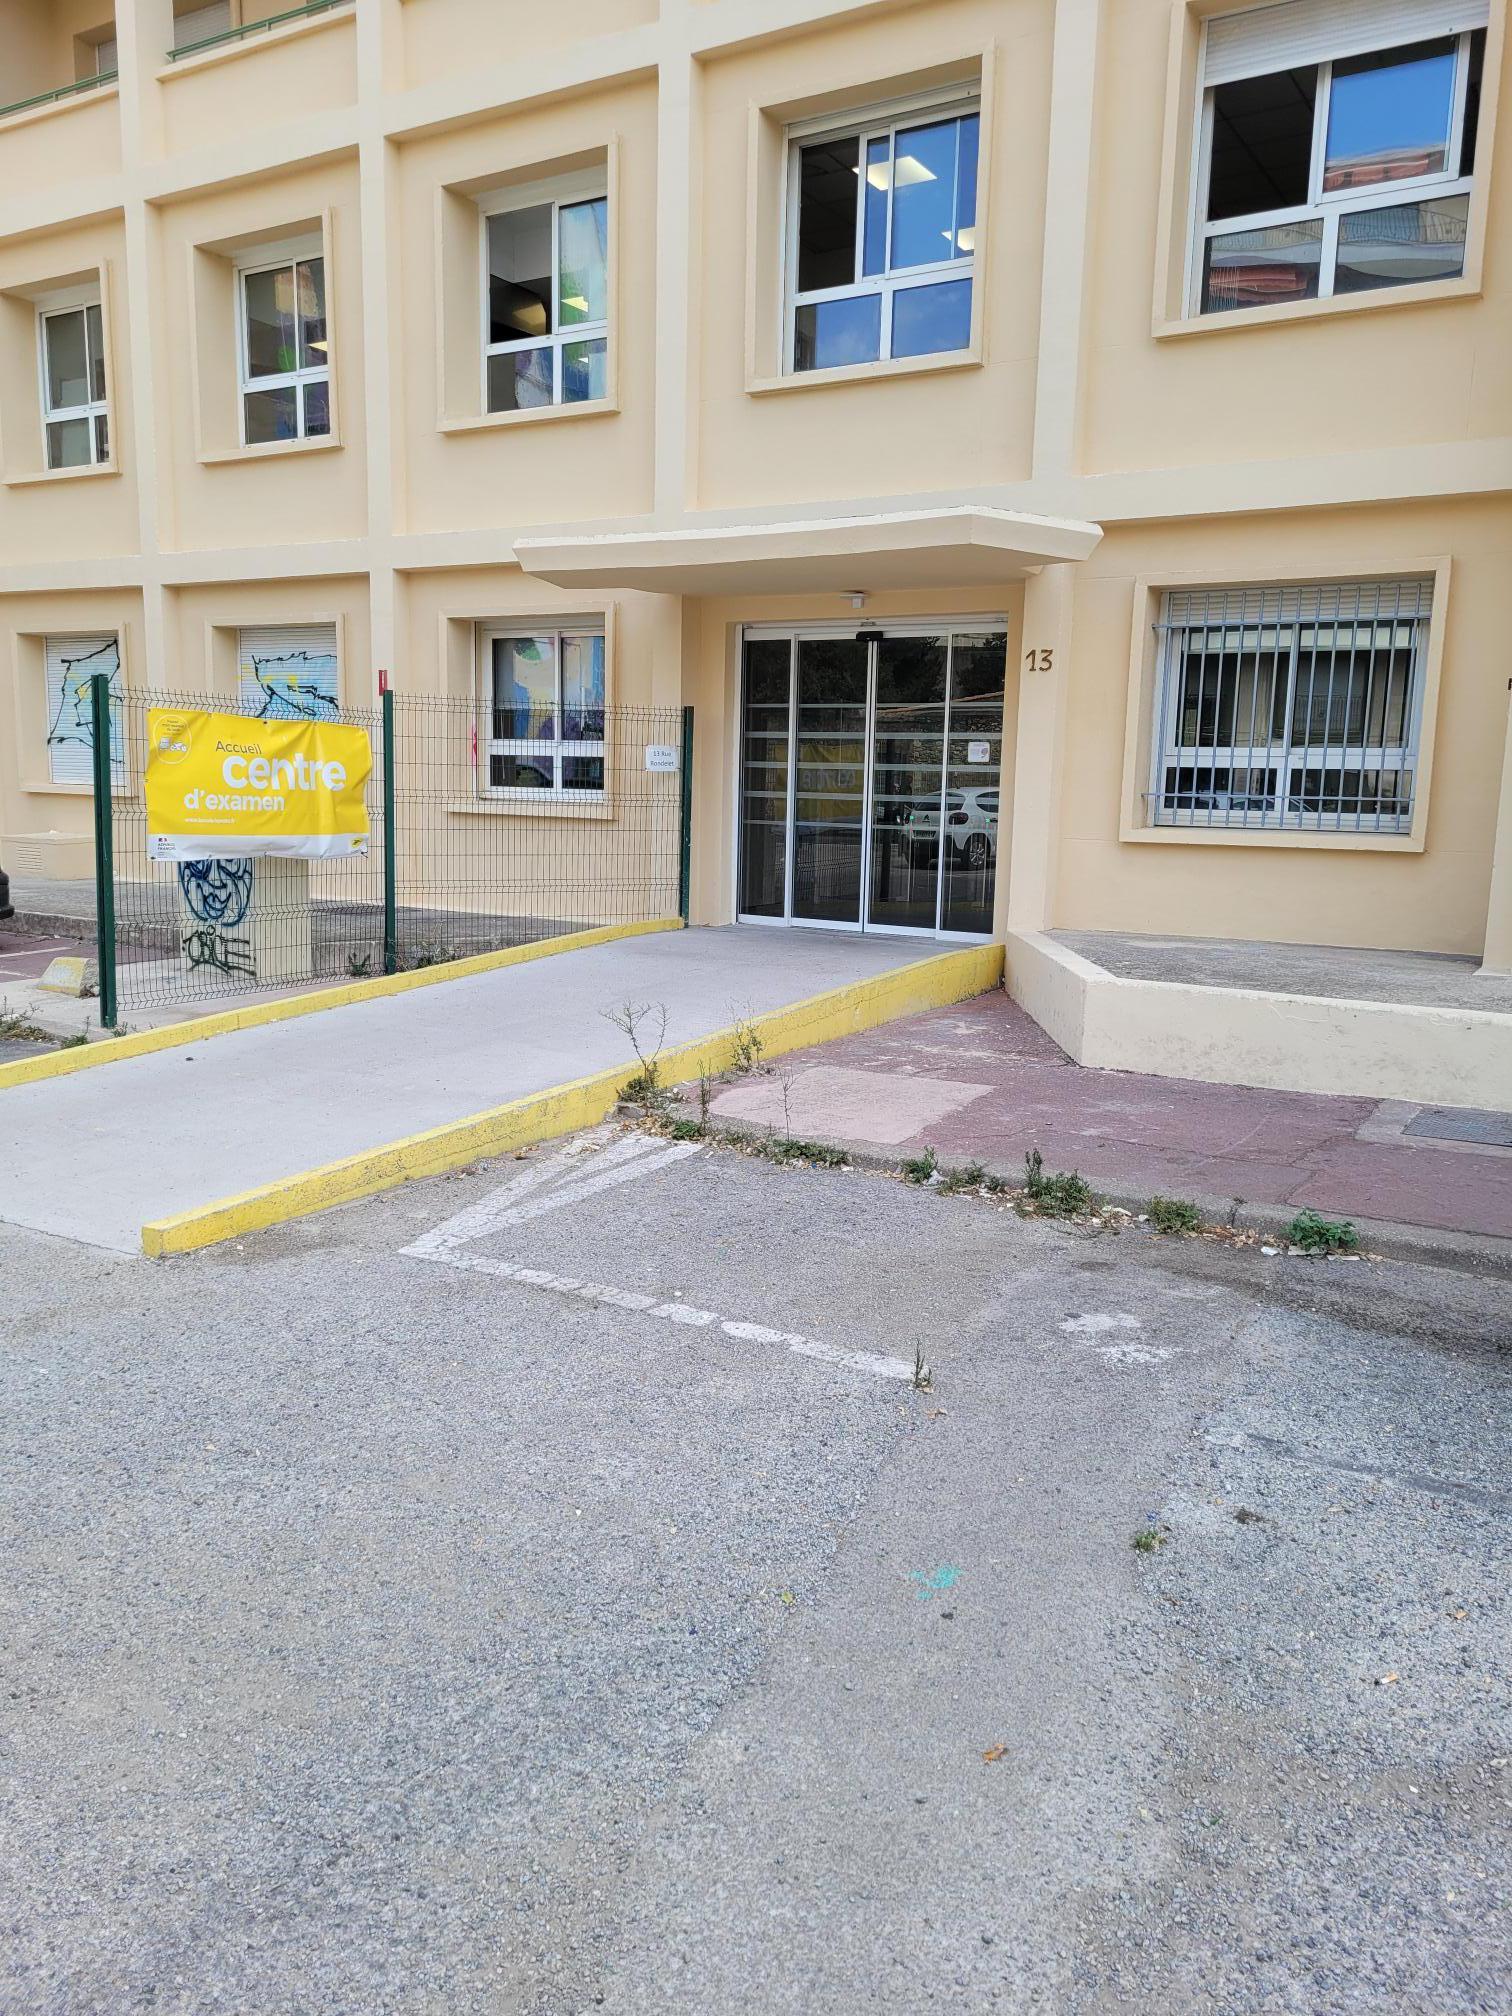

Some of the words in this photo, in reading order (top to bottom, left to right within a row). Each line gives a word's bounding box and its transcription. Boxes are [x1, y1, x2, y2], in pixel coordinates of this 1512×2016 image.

[1025, 649, 1054, 672] 13
[215, 740, 262, 755] Accueil
[222, 752, 347, 791] centre
[183, 788, 286, 811] d'examen
